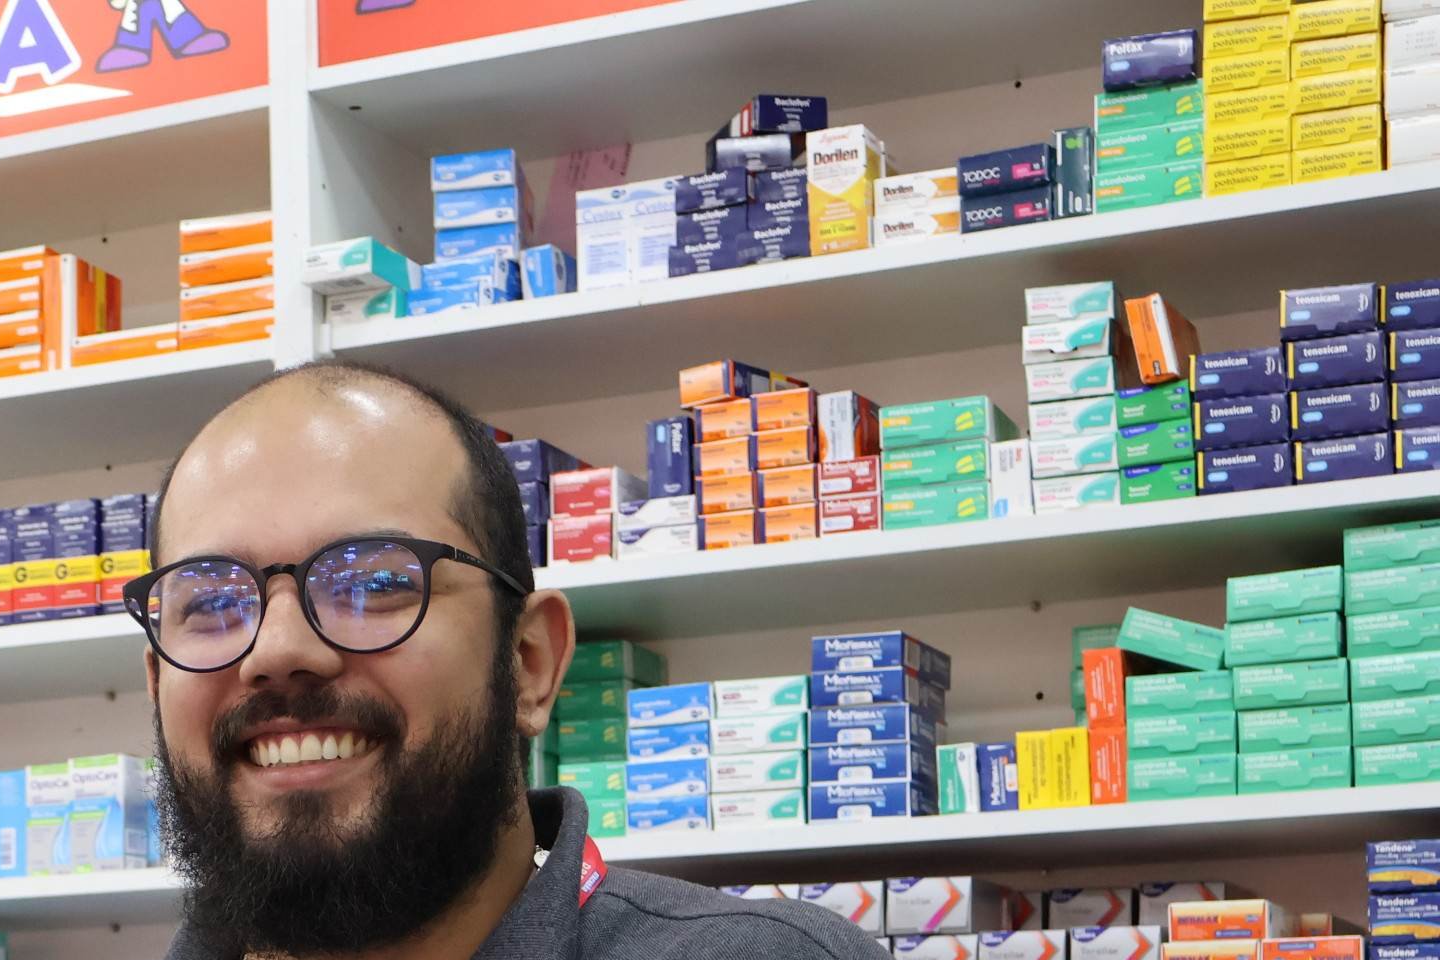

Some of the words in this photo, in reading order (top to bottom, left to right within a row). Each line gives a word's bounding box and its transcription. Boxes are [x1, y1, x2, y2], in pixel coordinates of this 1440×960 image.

[813, 149, 858, 166] Dorilen
[690, 172, 726, 186] Baclofen
[765, 199, 802, 213] Baclofen
[693, 209, 728, 222] Baclofen
[754, 227, 791, 241] Baclofen
[685, 241, 721, 254] Baclofen
[1296, 293, 1340, 304] tenoxicam
[1396, 287, 1439, 300] tenoxicam
[1406, 336, 1440, 347] tenoxica
[1304, 344, 1347, 357] tenoxicam
[1205, 357, 1248, 368] tenoxicam
[1307, 393, 1351, 406] tenoxicam
[1210, 405, 1253, 418] tenoxicam
[1312, 442, 1356, 457] tenoxicam
[1213, 454, 1256, 466] tenoxicam
